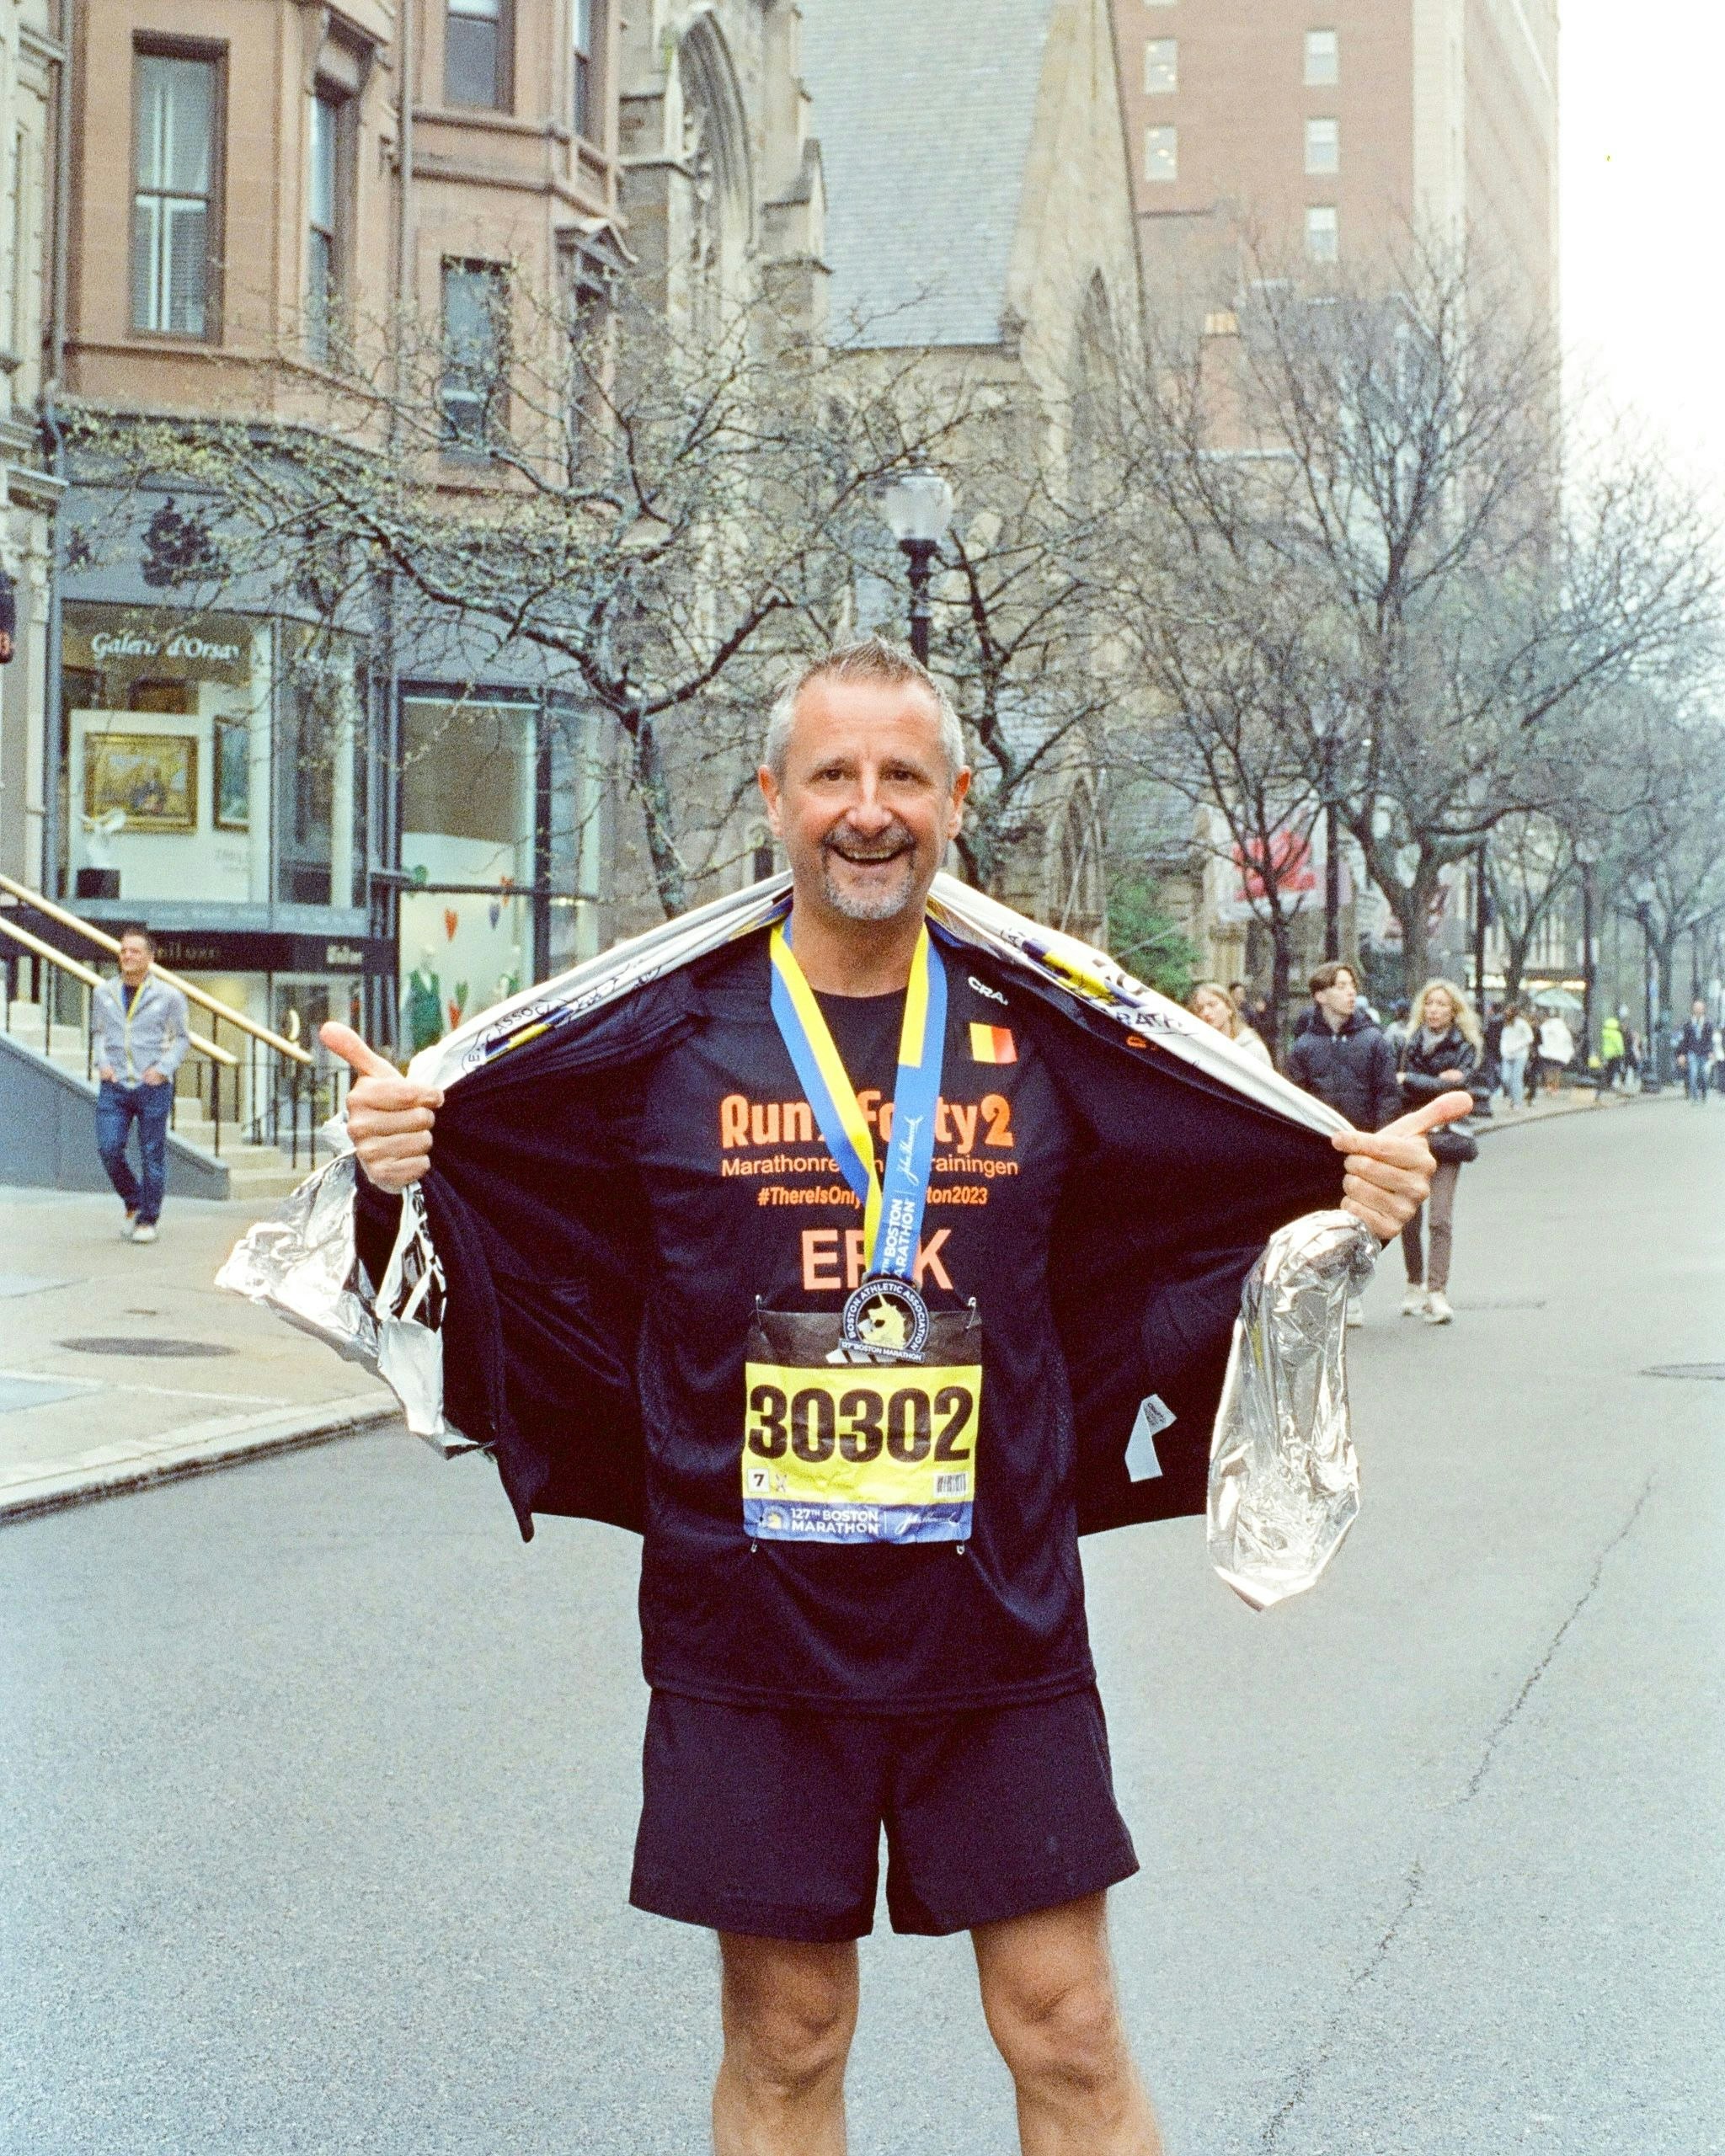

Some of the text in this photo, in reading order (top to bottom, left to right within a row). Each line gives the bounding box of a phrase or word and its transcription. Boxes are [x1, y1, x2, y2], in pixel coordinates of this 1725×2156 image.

[968, 976, 1008, 1006] CRA
[720, 1091, 1014, 1155] RunFoty2
[884, 1198, 903, 1257] BOSTON
[894, 1201, 916, 1279] ARATHON
[802, 1229, 953, 1290] EK
[846, 1283, 926, 1351] BOSTON ATHLETIC ASSOCIATION
[883, 1348, 922, 1361] MARATHON
[748, 1385, 974, 1464] 30302
[753, 1474, 765, 1487] 7
[791, 1521, 881, 1534] MARATHON
[823, 1509, 879, 1522] BOSTON
